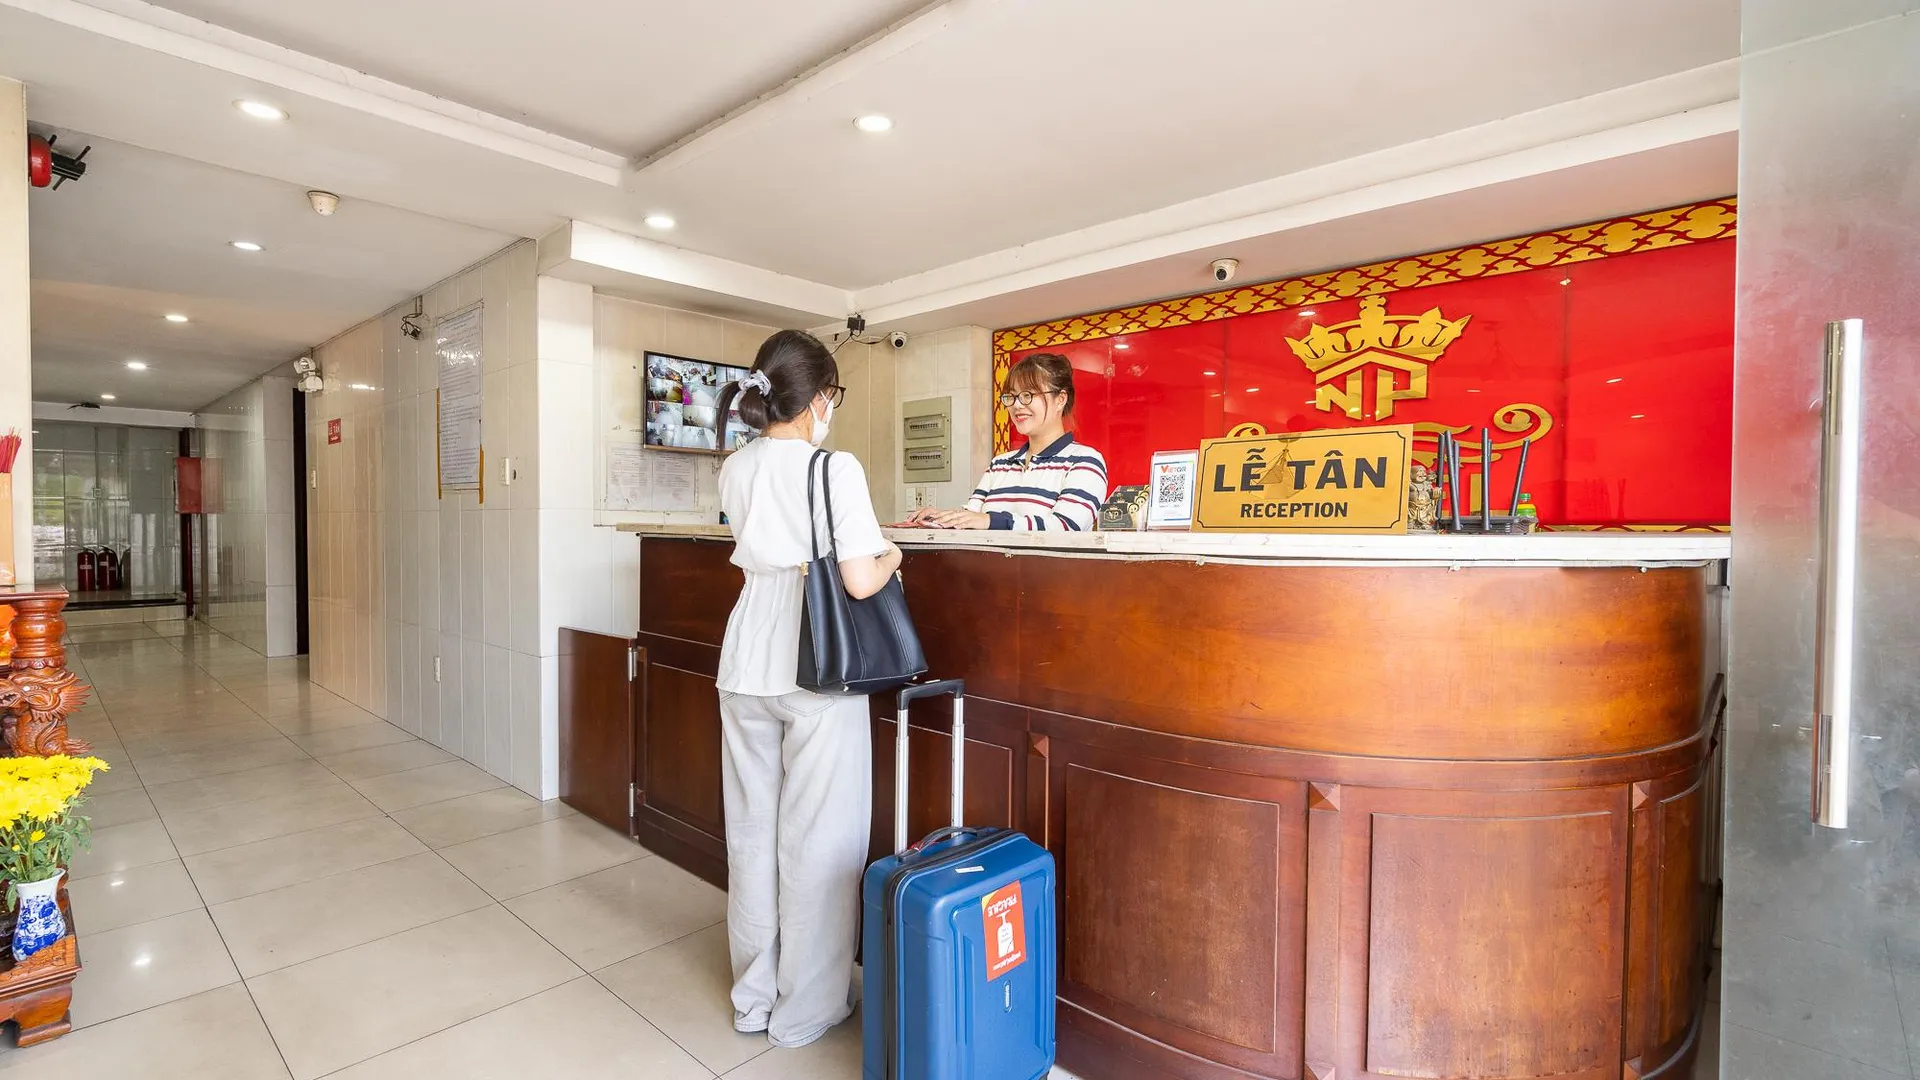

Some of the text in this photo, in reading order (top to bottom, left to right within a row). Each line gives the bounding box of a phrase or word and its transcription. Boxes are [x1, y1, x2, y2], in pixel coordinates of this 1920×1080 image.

[1213, 447, 1388, 492] LỄ TÂN
[1240, 501, 1348, 518] RECEPTION
[987, 893, 1018, 918] FRAGILE
